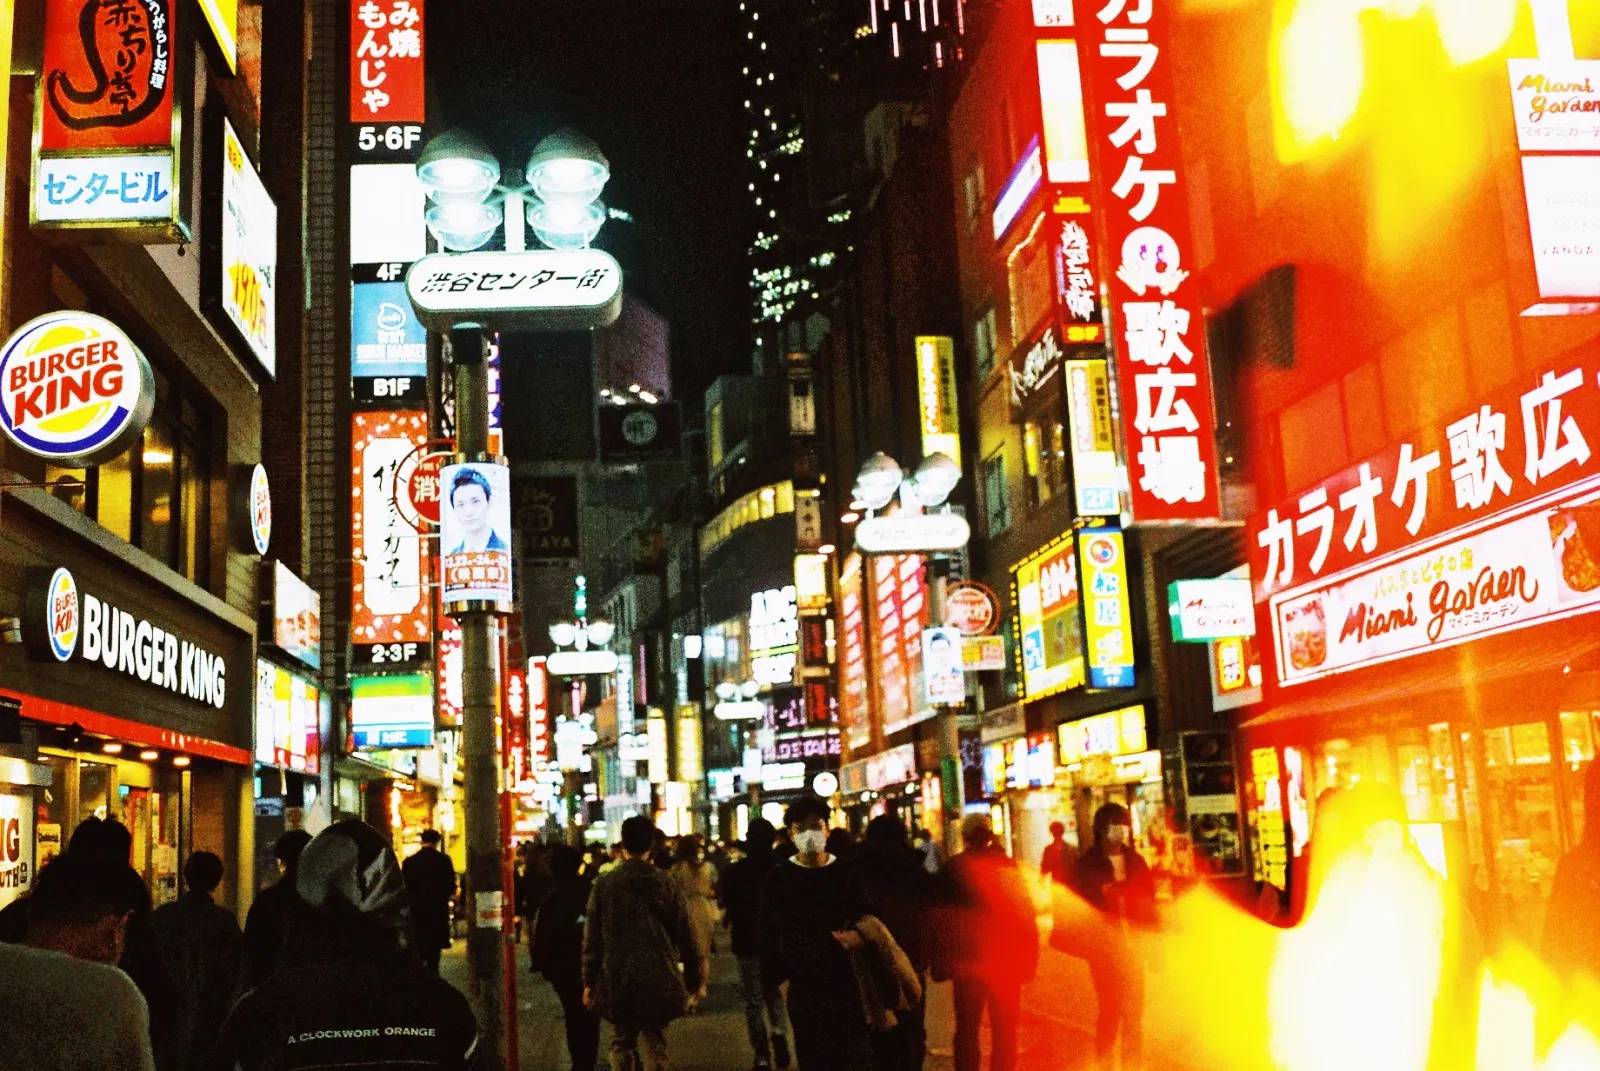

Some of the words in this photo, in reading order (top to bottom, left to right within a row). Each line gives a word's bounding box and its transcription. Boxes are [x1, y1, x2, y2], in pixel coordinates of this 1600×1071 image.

[43, 170, 168, 206] センタービル
[376, 263, 403, 281] 4F
[420, 268, 609, 293] 渋谷センター街
[9, 340, 119, 393] BURGER
[373, 377, 411, 397] B1F
[14, 363, 124, 428] KING
[1121, 299, 1207, 505] 歌広場
[1257, 367, 1600, 595] カラオケ歌広
[1338, 591, 1418, 644] Miami
[82, 593, 178, 692] BURGER
[180, 642, 226, 709] KING
[287, 1035, 296, 1045] A
[299, 1028, 380, 1042] CLOCKWORK
[384, 1026, 436, 1037] ORANGE
